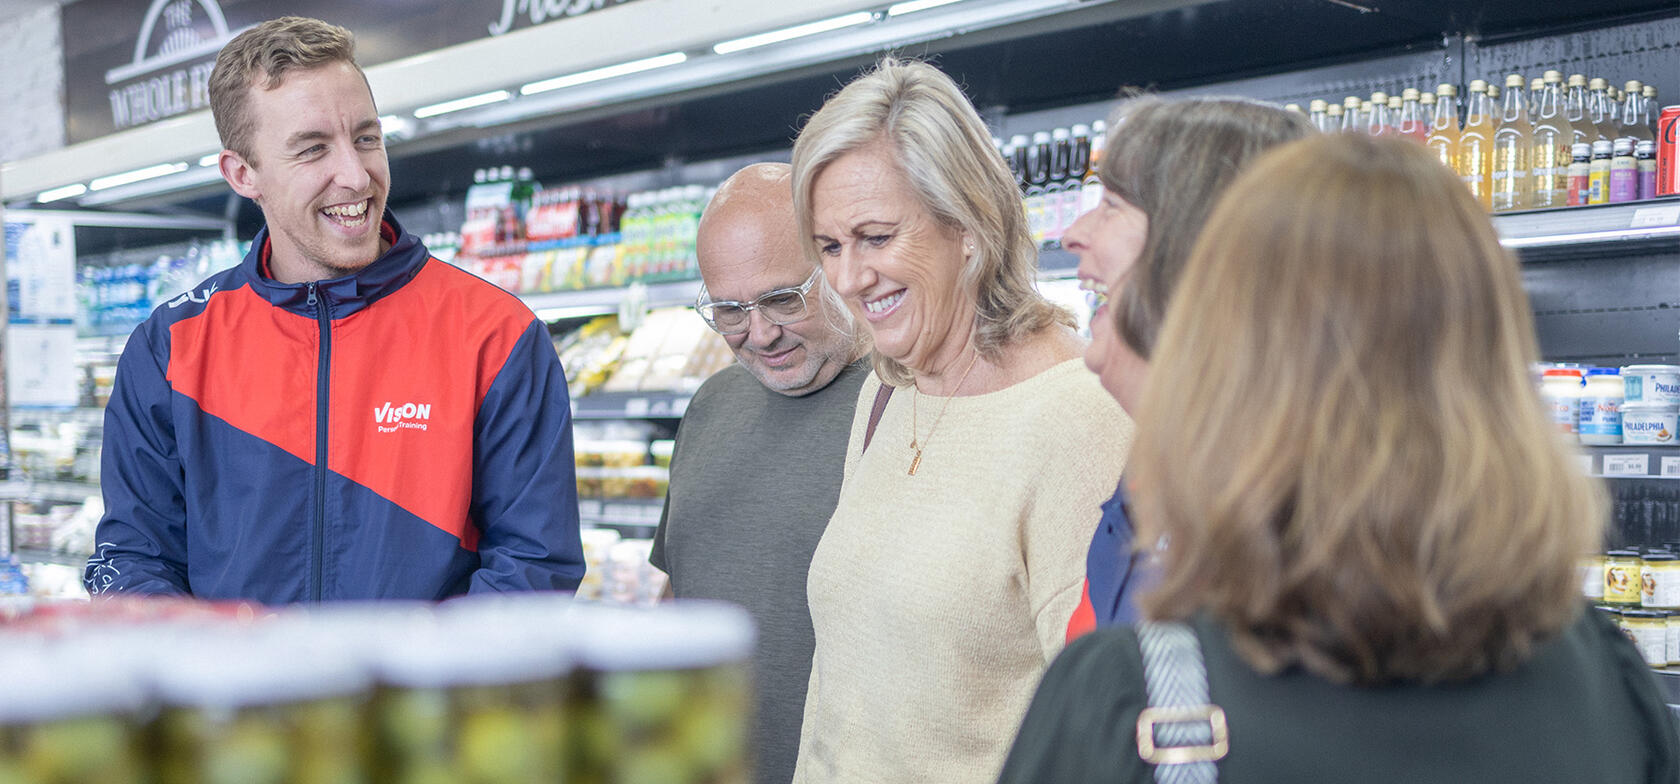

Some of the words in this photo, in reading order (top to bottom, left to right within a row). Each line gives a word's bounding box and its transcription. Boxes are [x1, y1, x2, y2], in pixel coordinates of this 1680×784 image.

[164, 0, 193, 30] THE
[109, 70, 188, 129] WHOLE
[374, 401, 431, 423] VISON
[398, 421, 428, 432] Training
[1623, 421, 1665, 432] PHILADELPHIA
